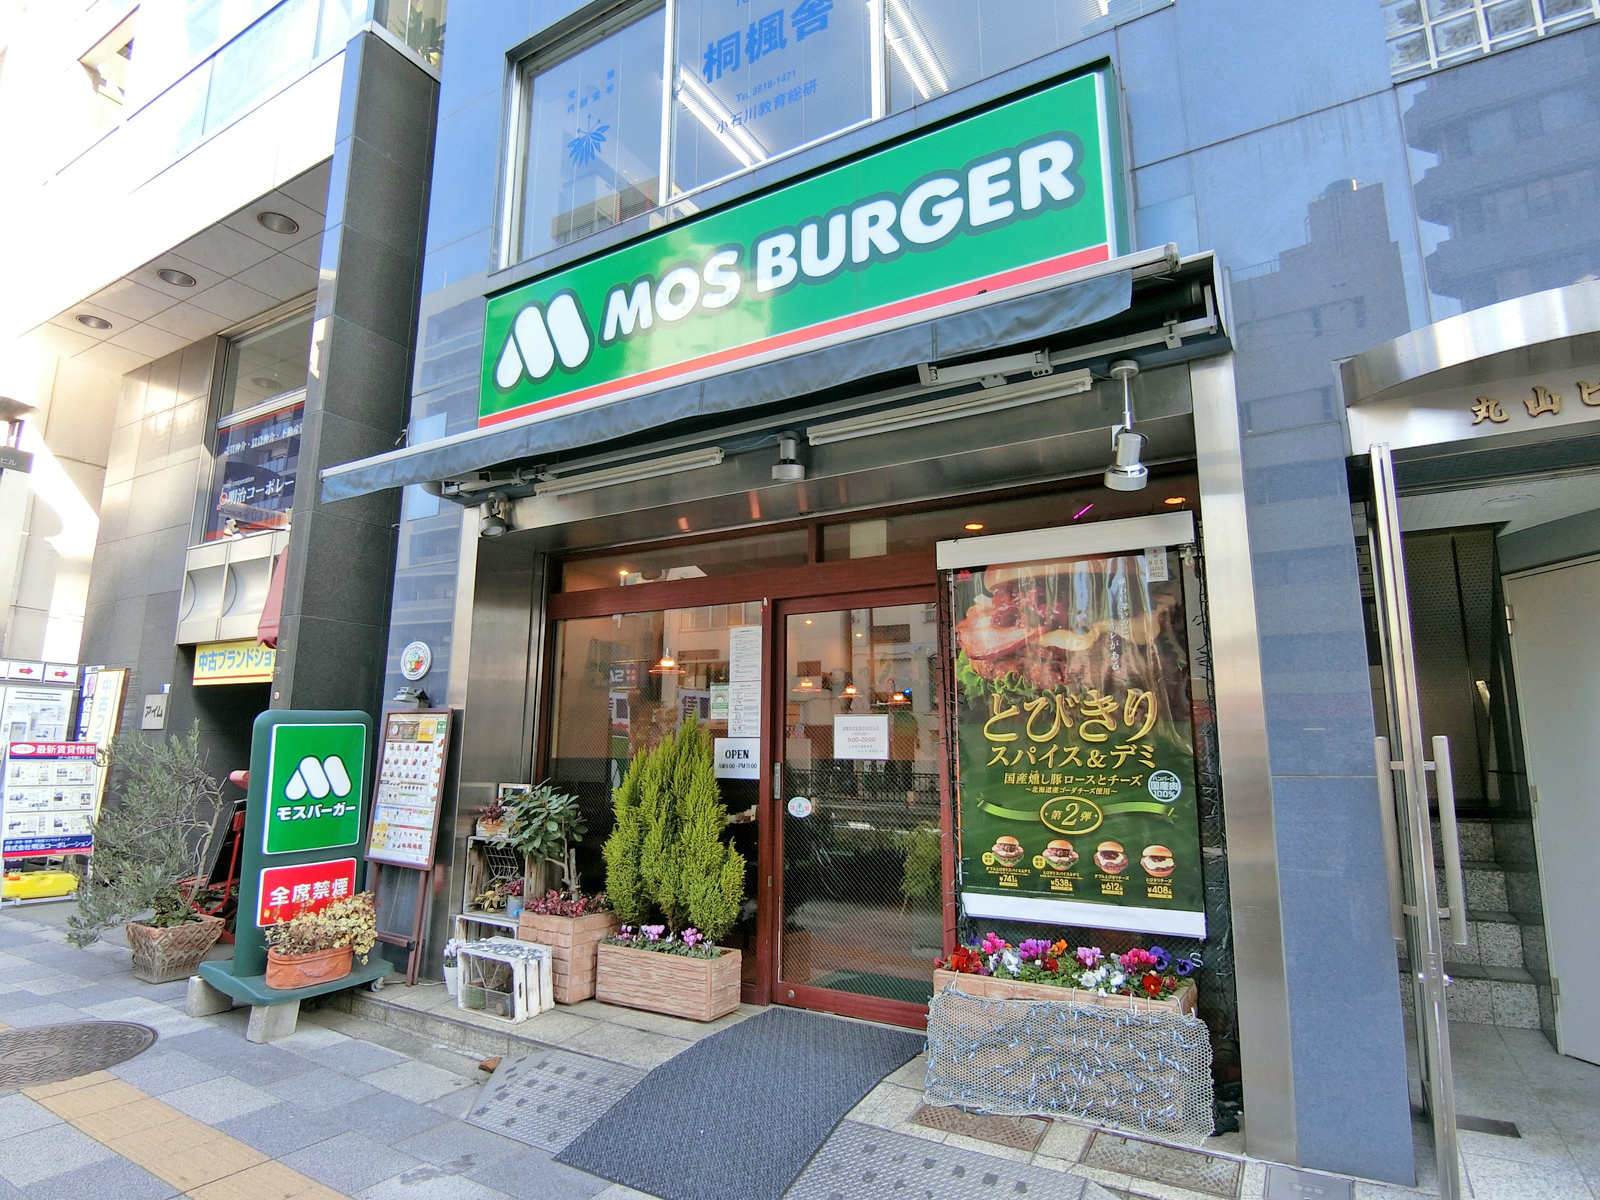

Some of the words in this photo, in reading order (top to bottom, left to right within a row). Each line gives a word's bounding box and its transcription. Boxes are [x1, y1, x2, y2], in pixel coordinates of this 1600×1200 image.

[717, 79, 817, 133] 小石川教育総研
[602, 249, 741, 341] MOS
[756, 139, 1076, 293] BURGER
[144, 705, 163, 718] アイム
[983, 689, 1158, 742] とびきり
[725, 749, 749, 759] OPEN
[986, 743, 1156, 769] スパイス&デミ
[1153, 790, 1176, 799] 100%
[276, 802, 357, 821] モスバーガー
[270, 877, 349, 906] 全席禁煙
[1101, 882, 1120, 891] ¥612
[1147, 885, 1168, 895] ¥408
